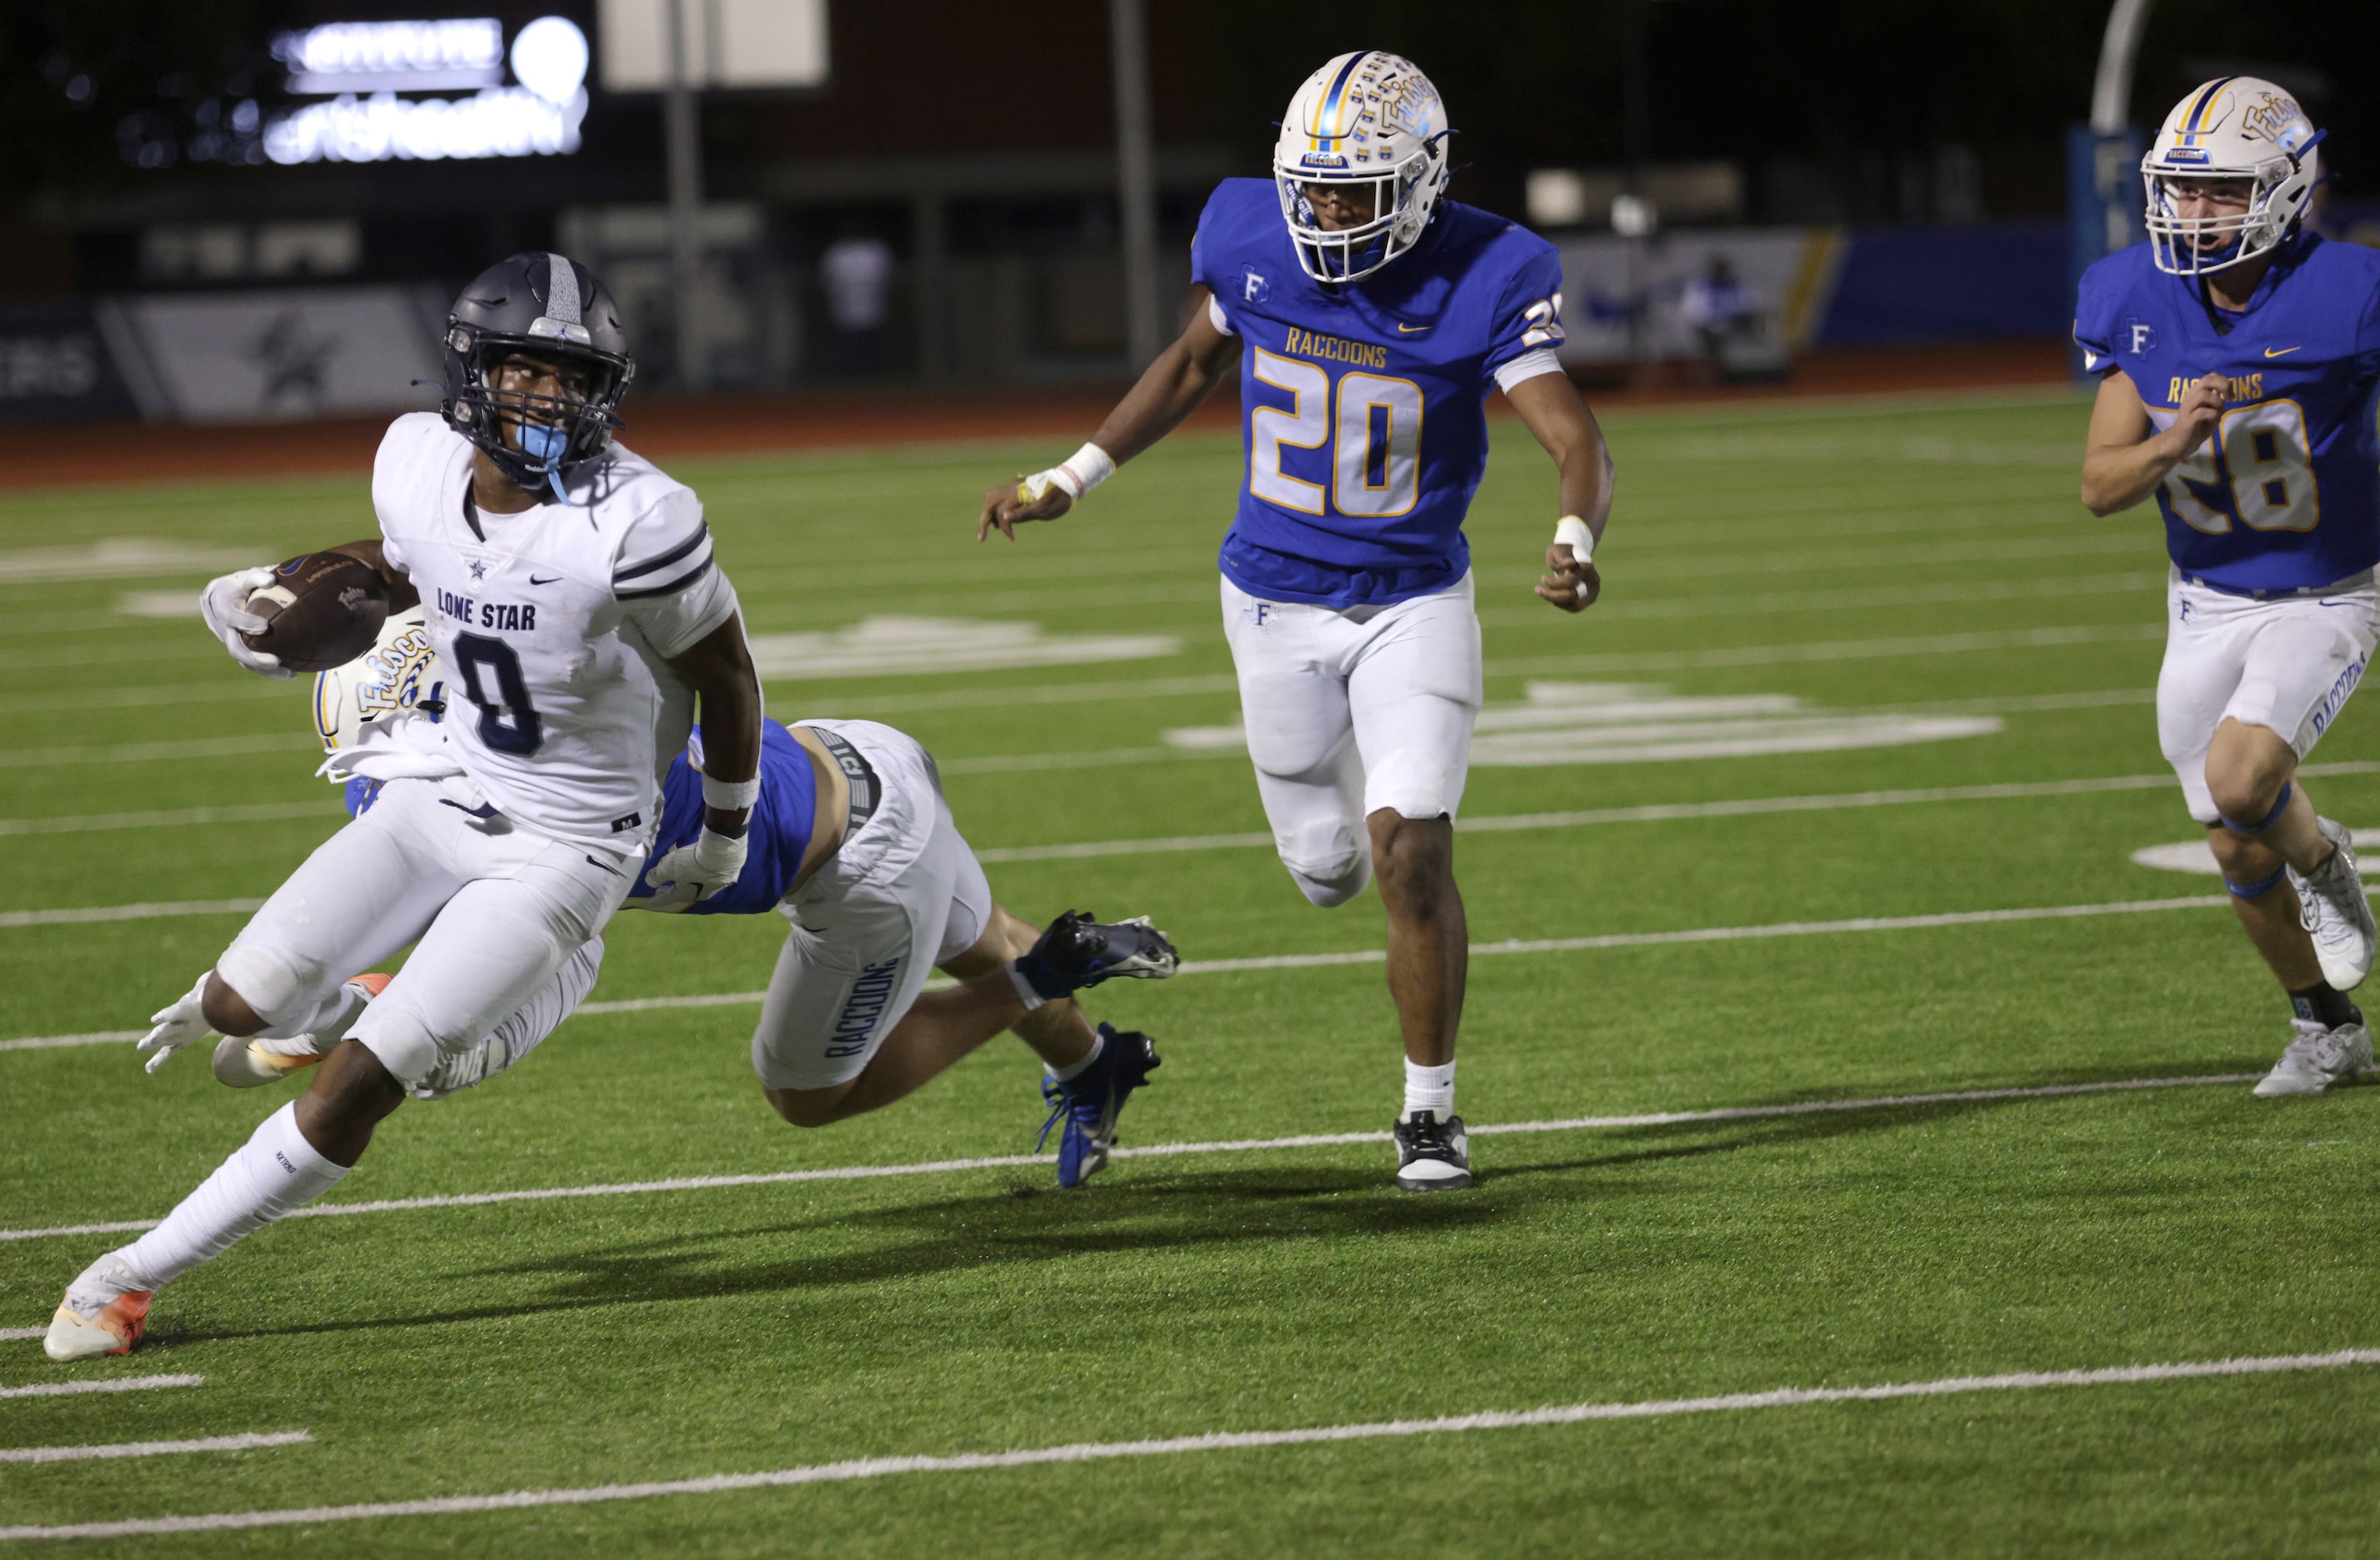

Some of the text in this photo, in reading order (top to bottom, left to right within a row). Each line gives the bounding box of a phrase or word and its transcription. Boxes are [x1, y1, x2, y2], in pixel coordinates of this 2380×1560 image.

[1305, 155, 1343, 166] RACCOONS
[1245, 272, 1265, 302] F
[1285, 326, 1387, 369] RACCOONS
[2130, 325, 2149, 354] F
[1249, 346, 1424, 518] 20
[2145, 398, 2319, 535] 28
[438, 587, 536, 630] LONE STAR
[1256, 604, 1271, 625] F
[2181, 600, 2191, 621] F
[356, 629, 430, 713] Frisco
[452, 629, 545, 758] 0
[621, 818, 633, 831] M
